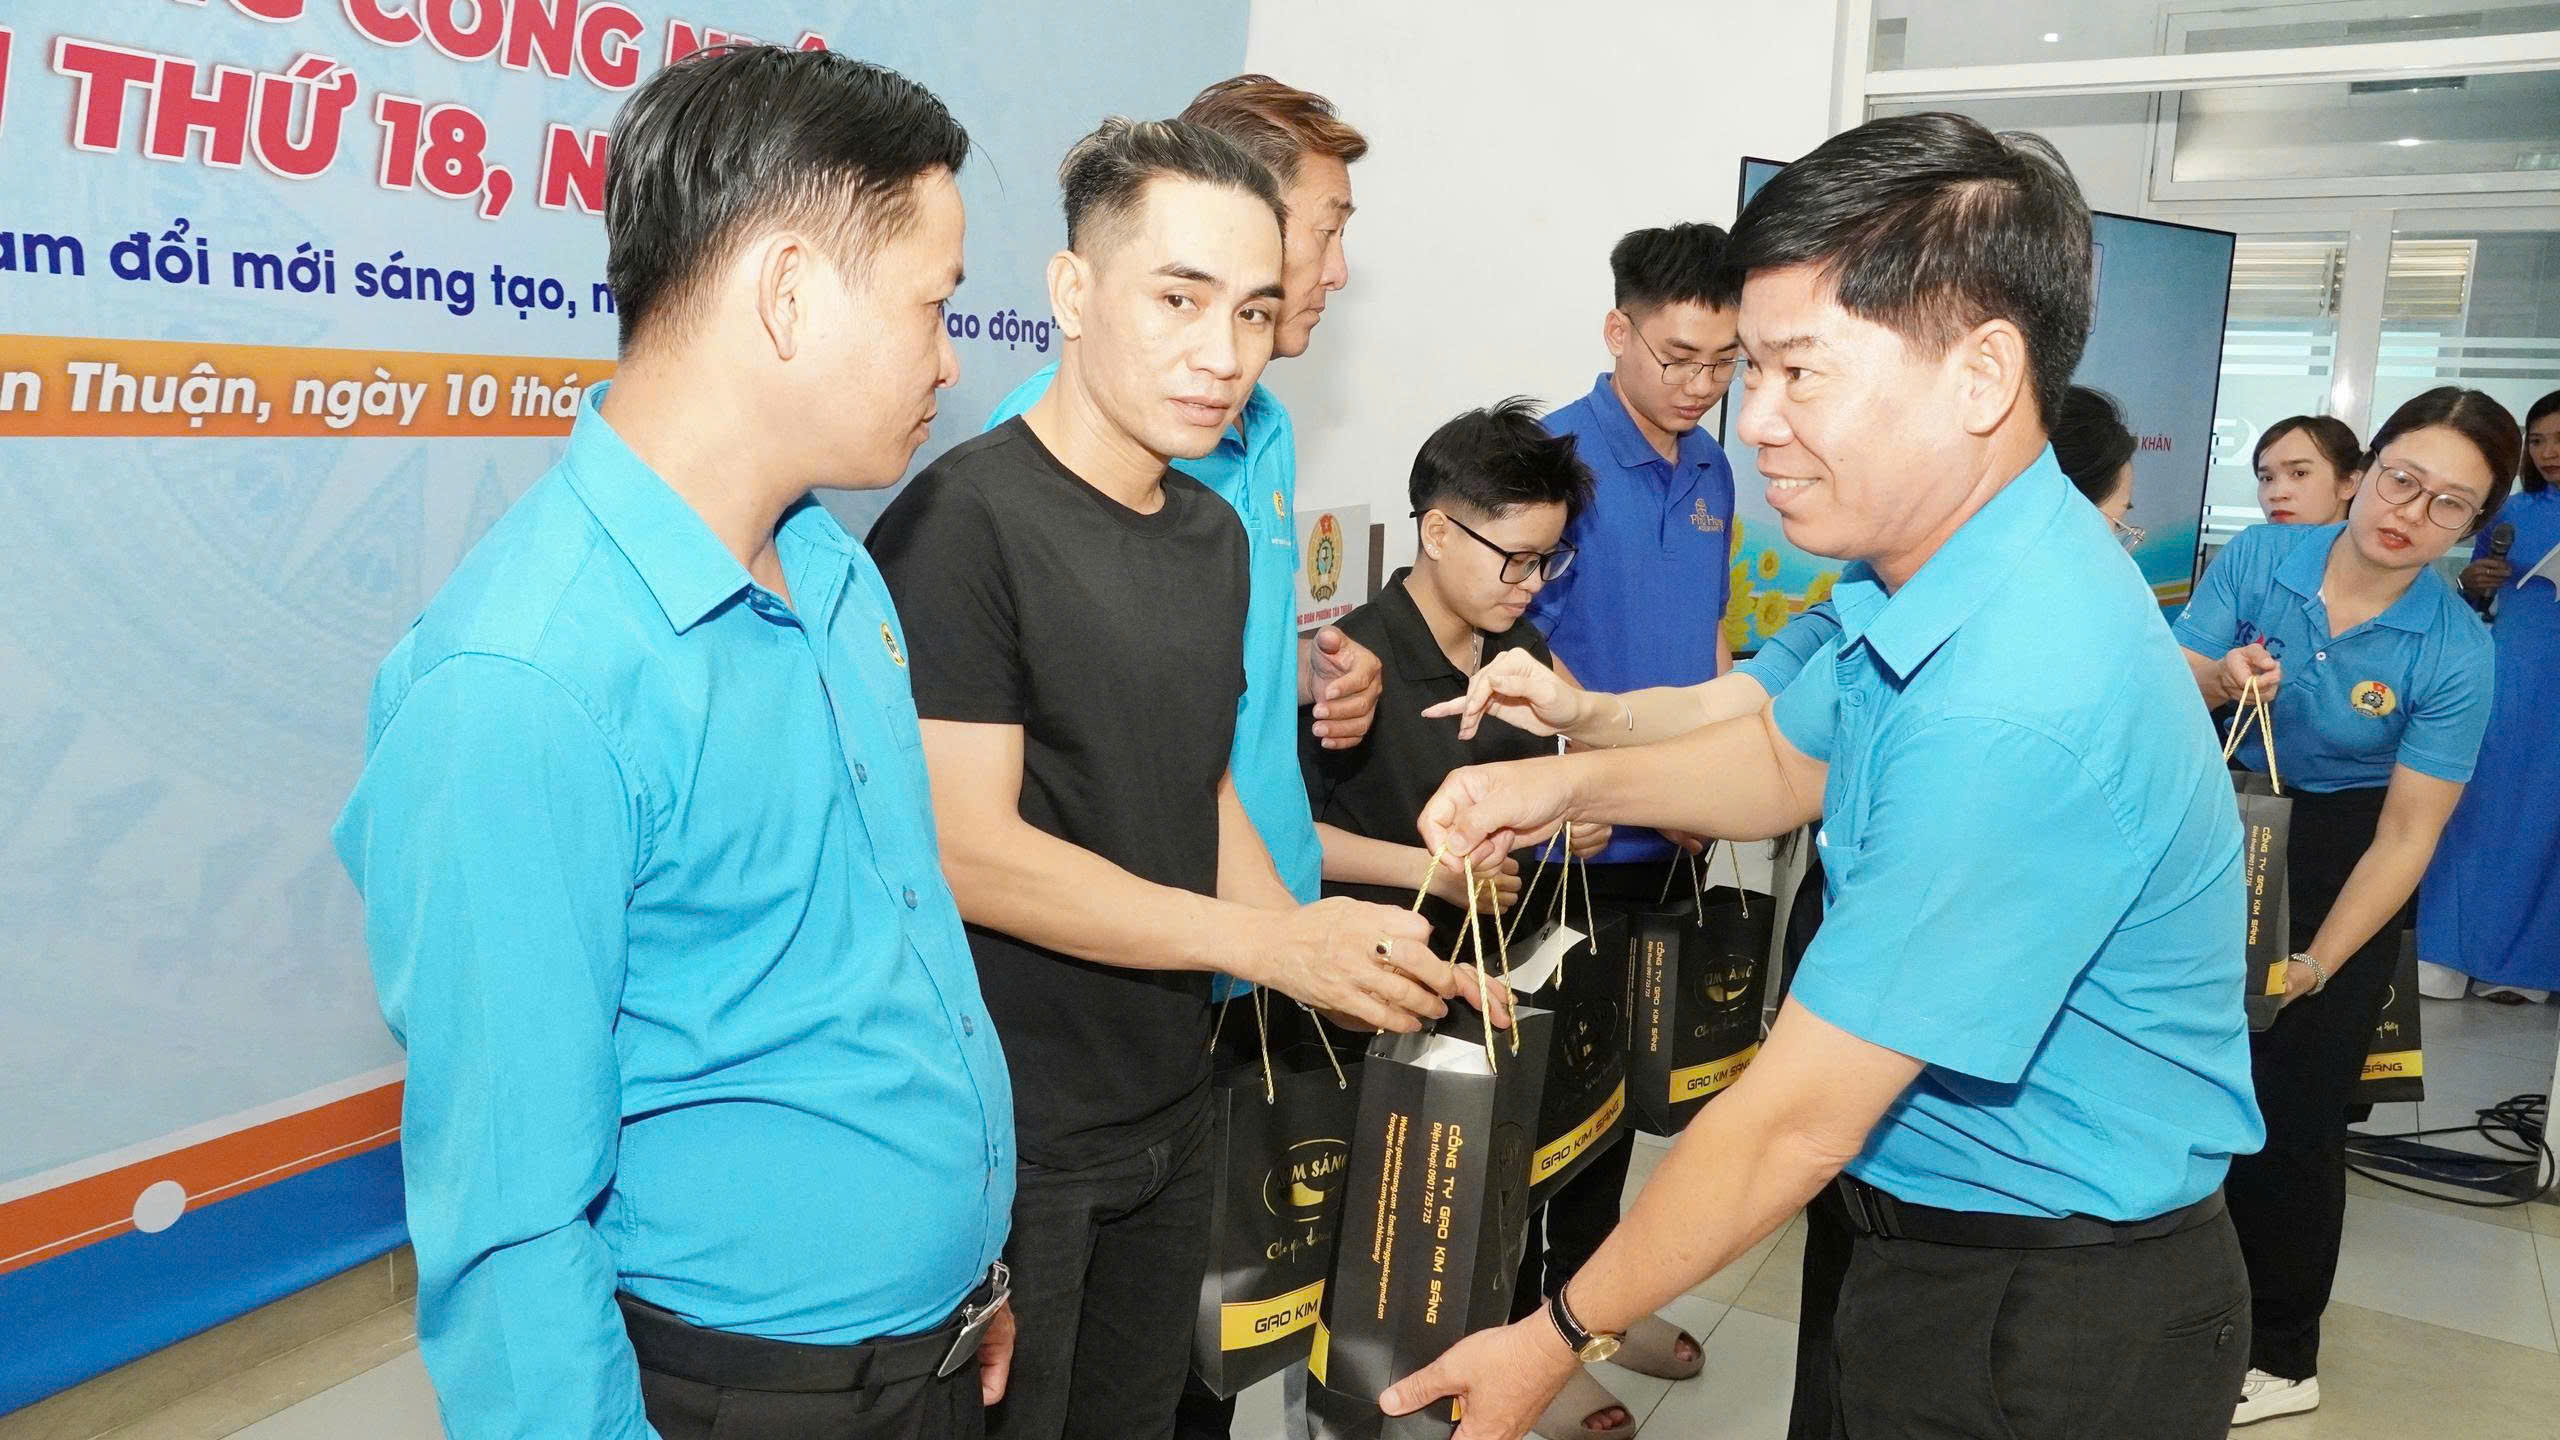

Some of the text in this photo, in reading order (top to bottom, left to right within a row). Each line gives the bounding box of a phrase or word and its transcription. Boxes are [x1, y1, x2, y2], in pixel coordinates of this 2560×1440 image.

[55, 38, 357, 178] THỨ
[377, 95, 514, 220] 18,
[109, 217, 210, 285] đổi
[232, 241, 336, 294] mới
[354, 250, 475, 316] sáng
[491, 264, 576, 319] tạo,
[942, 306, 980, 339] ao
[67, 361, 272, 428] Thuận,
[292, 366, 428, 429] ngày
[446, 373, 498, 417] 10
[2261, 826, 2272, 853] CÔNG
[2259, 857, 2267, 871] TY
[2252, 899, 2261, 915] KIM
[1655, 970, 1662, 983] TY
[1651, 1008, 1660, 1024] KIM
[1712, 1069, 1729, 1083] KIM
[1386, 1112, 1398, 1146] Fanpage:
[1397, 1115, 1408, 1146] Website:
[1573, 1127, 1593, 1150] KIM
[1422, 1121, 1443, 1225] Điện thoại: 0901 725 725
[1387, 1214, 1396, 1236] Email:
[1426, 1124, 1463, 1325] CÔNG TY GẠO KIM SÁNG
[1254, 1299, 1319, 1334] GẠO KIM
